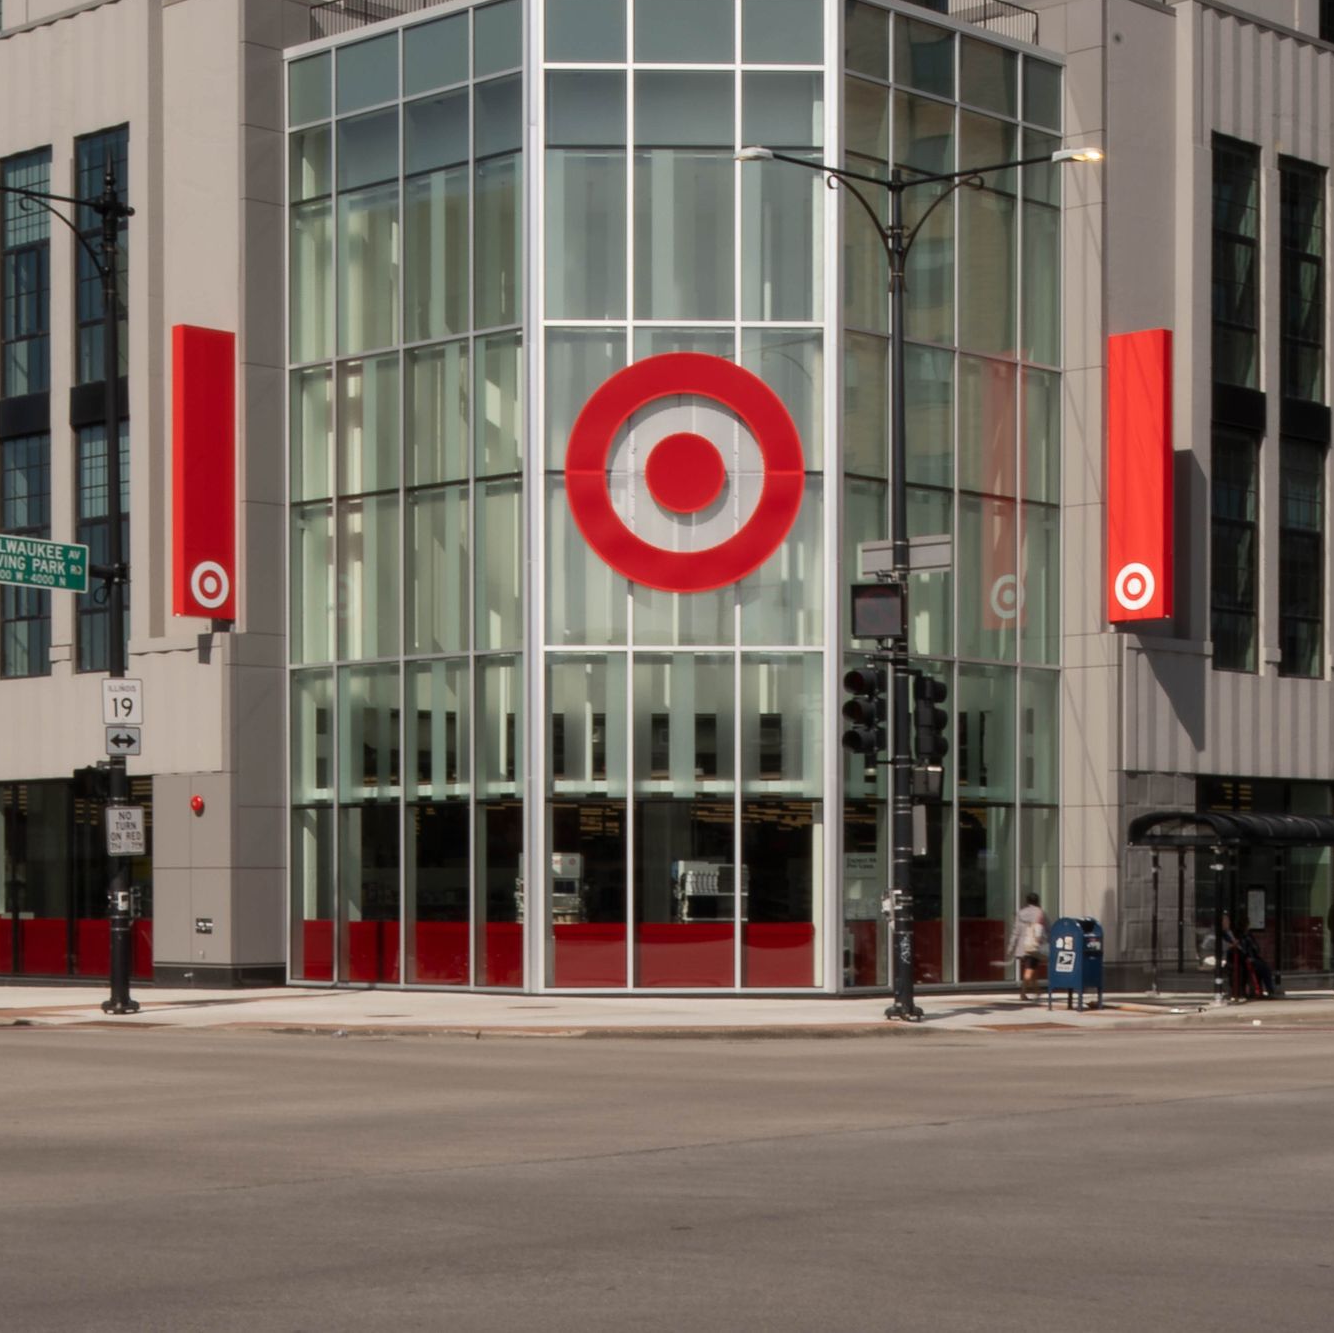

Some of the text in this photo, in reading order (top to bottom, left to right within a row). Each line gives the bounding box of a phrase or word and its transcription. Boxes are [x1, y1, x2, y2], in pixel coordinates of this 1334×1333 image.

[68, 550, 81, 560] AV
[32, 558, 66, 576] PARK
[15, 571, 24, 581] W
[30, 573, 55, 585] 4000
[59, 576, 67, 586] N
[112, 697, 133, 717] 19
[119, 811, 131, 820] NO
[115, 821, 137, 830] TURN
[110, 831, 141, 841] ON RED
